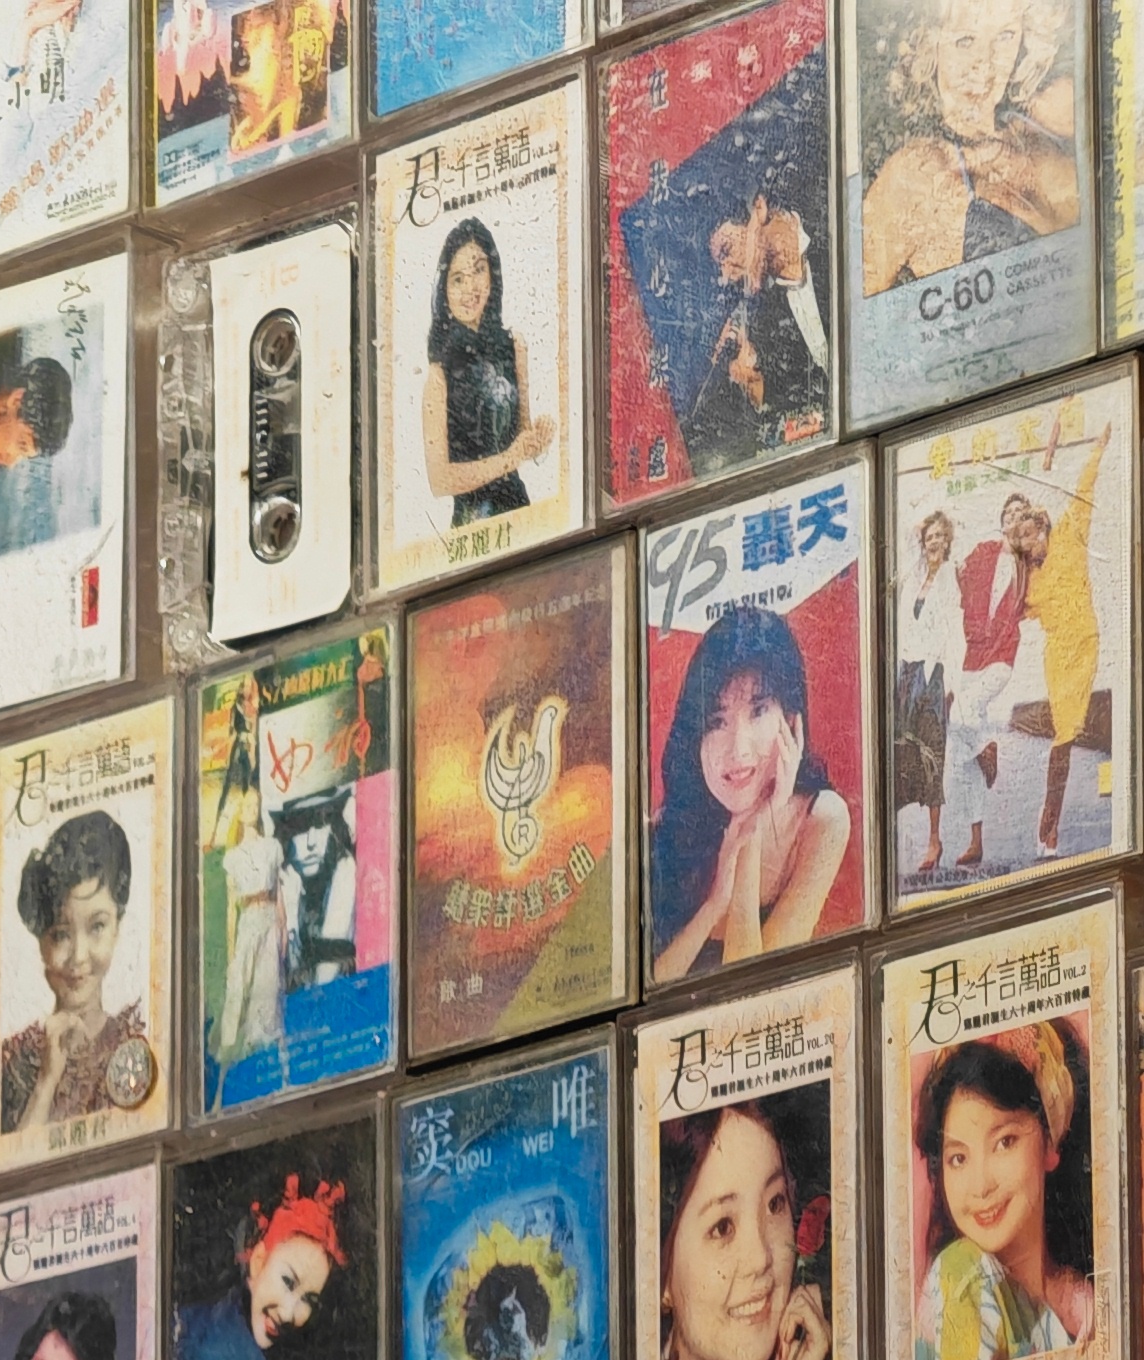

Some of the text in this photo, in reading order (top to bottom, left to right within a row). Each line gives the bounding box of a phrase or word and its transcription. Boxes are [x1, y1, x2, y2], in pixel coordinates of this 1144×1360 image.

[918, 268, 995, 321] C-60
[648, 513, 736, 637] 95
[741, 484, 848, 571] 轟天
